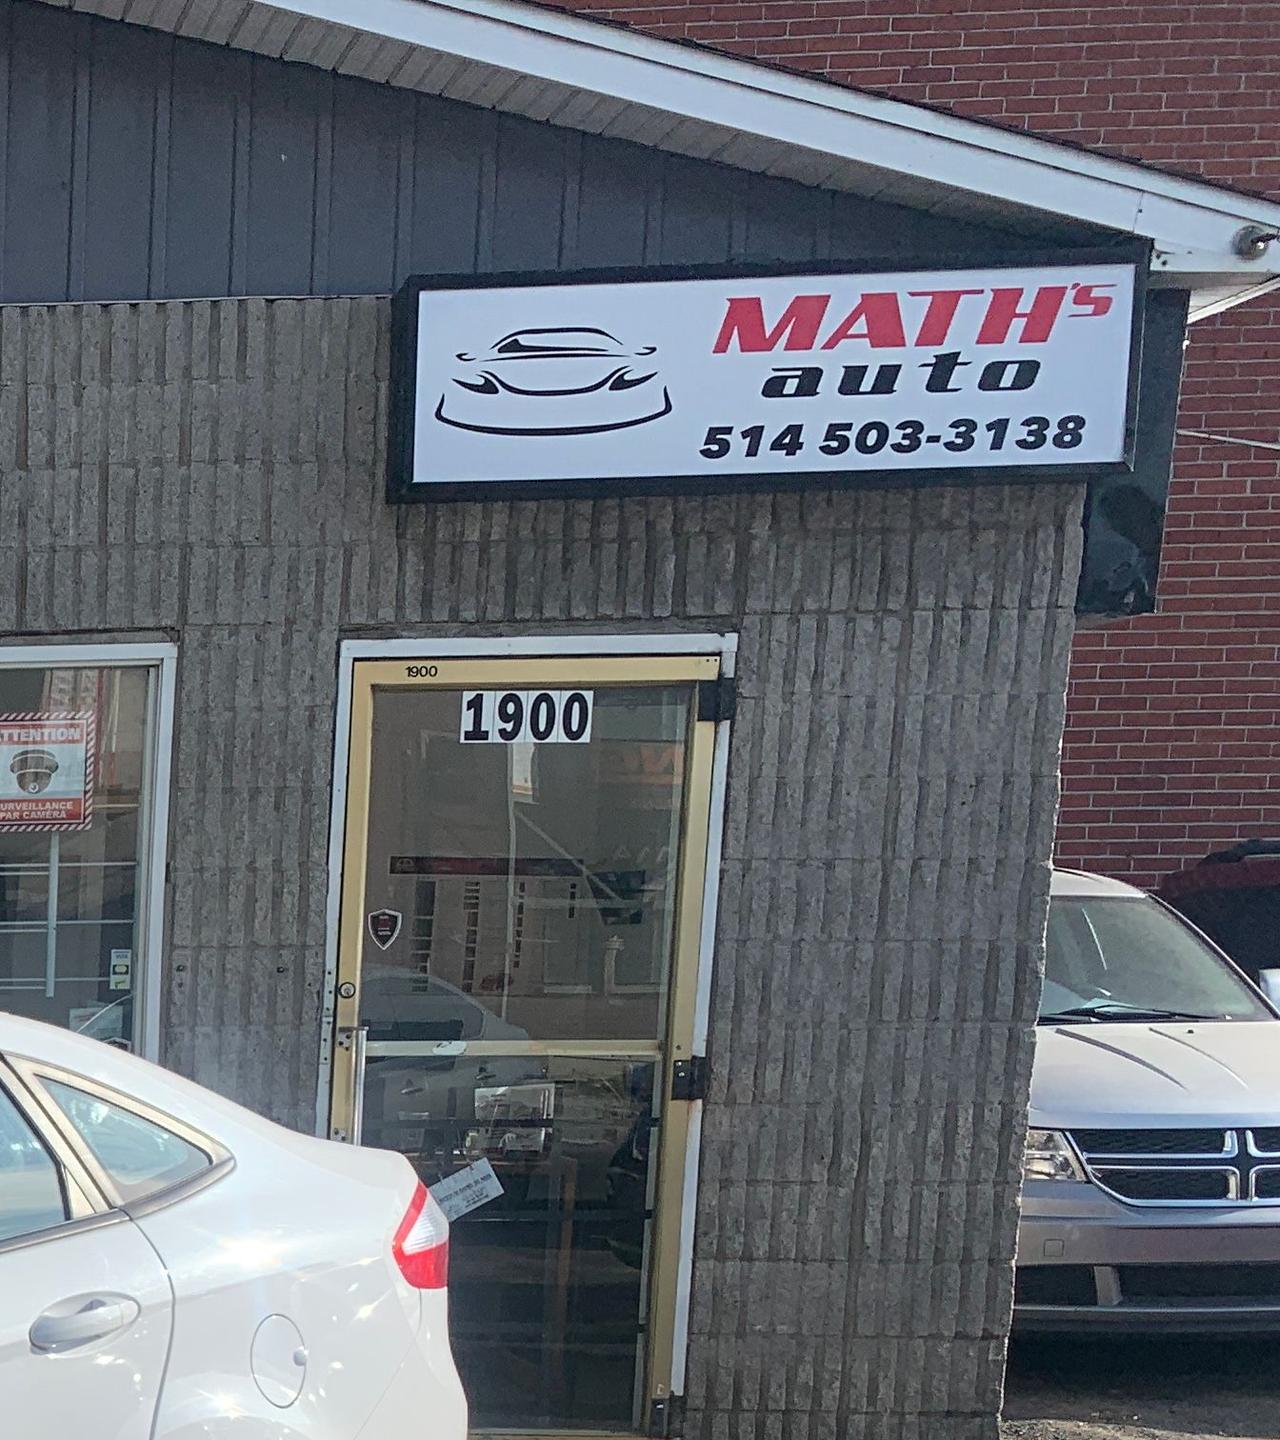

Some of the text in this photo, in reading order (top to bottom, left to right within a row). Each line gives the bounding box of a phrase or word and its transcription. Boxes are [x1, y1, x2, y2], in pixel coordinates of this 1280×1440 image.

[760, 351, 1042, 399] auto
[698, 413, 1087, 460] 514 503-3138
[404, 665, 439, 679] 1900
[462, 691, 590, 742] 1900
[0, 811, 20, 820] PAR
